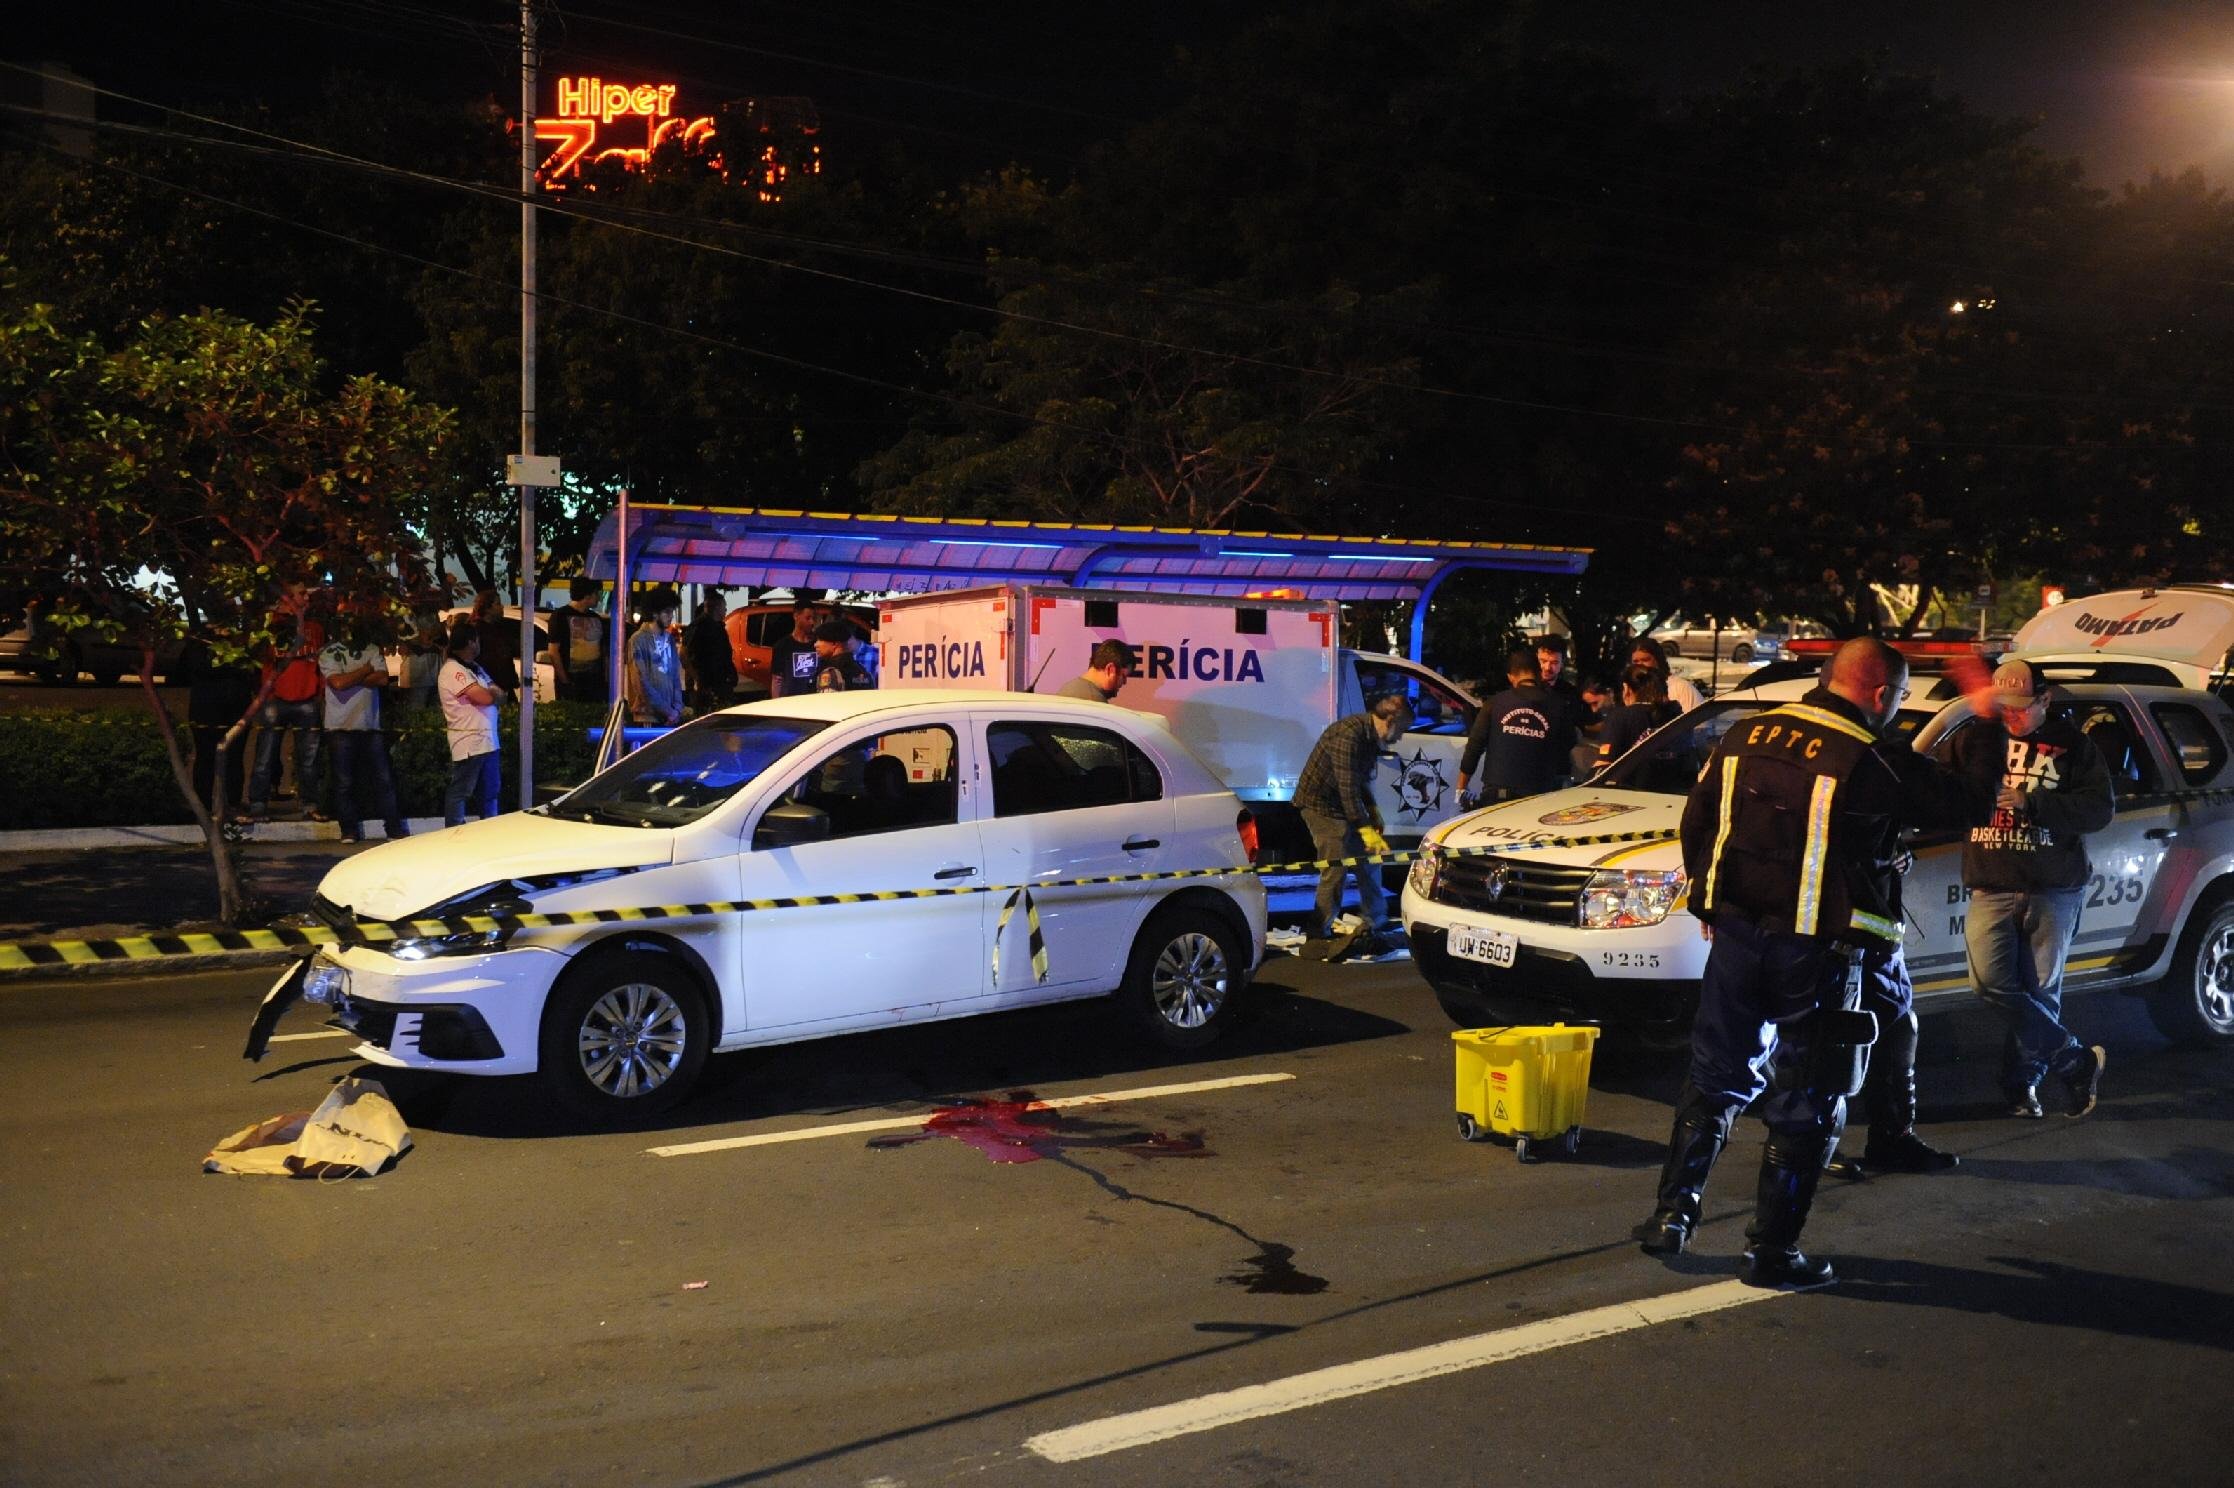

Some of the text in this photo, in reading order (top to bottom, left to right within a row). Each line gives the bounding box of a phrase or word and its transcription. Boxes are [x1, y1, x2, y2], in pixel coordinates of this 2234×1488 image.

[558, 77, 676, 123] Hiper
[2075, 612, 2184, 636] PATAMO
[899, 635, 985, 679] PERÍCIA
[1502, 726, 1546, 738] PERÍCIAS
[1747, 725, 1822, 759] EPTC
[1470, 826, 1568, 843] POLÍC
[1603, 952, 1660, 968] 9235
